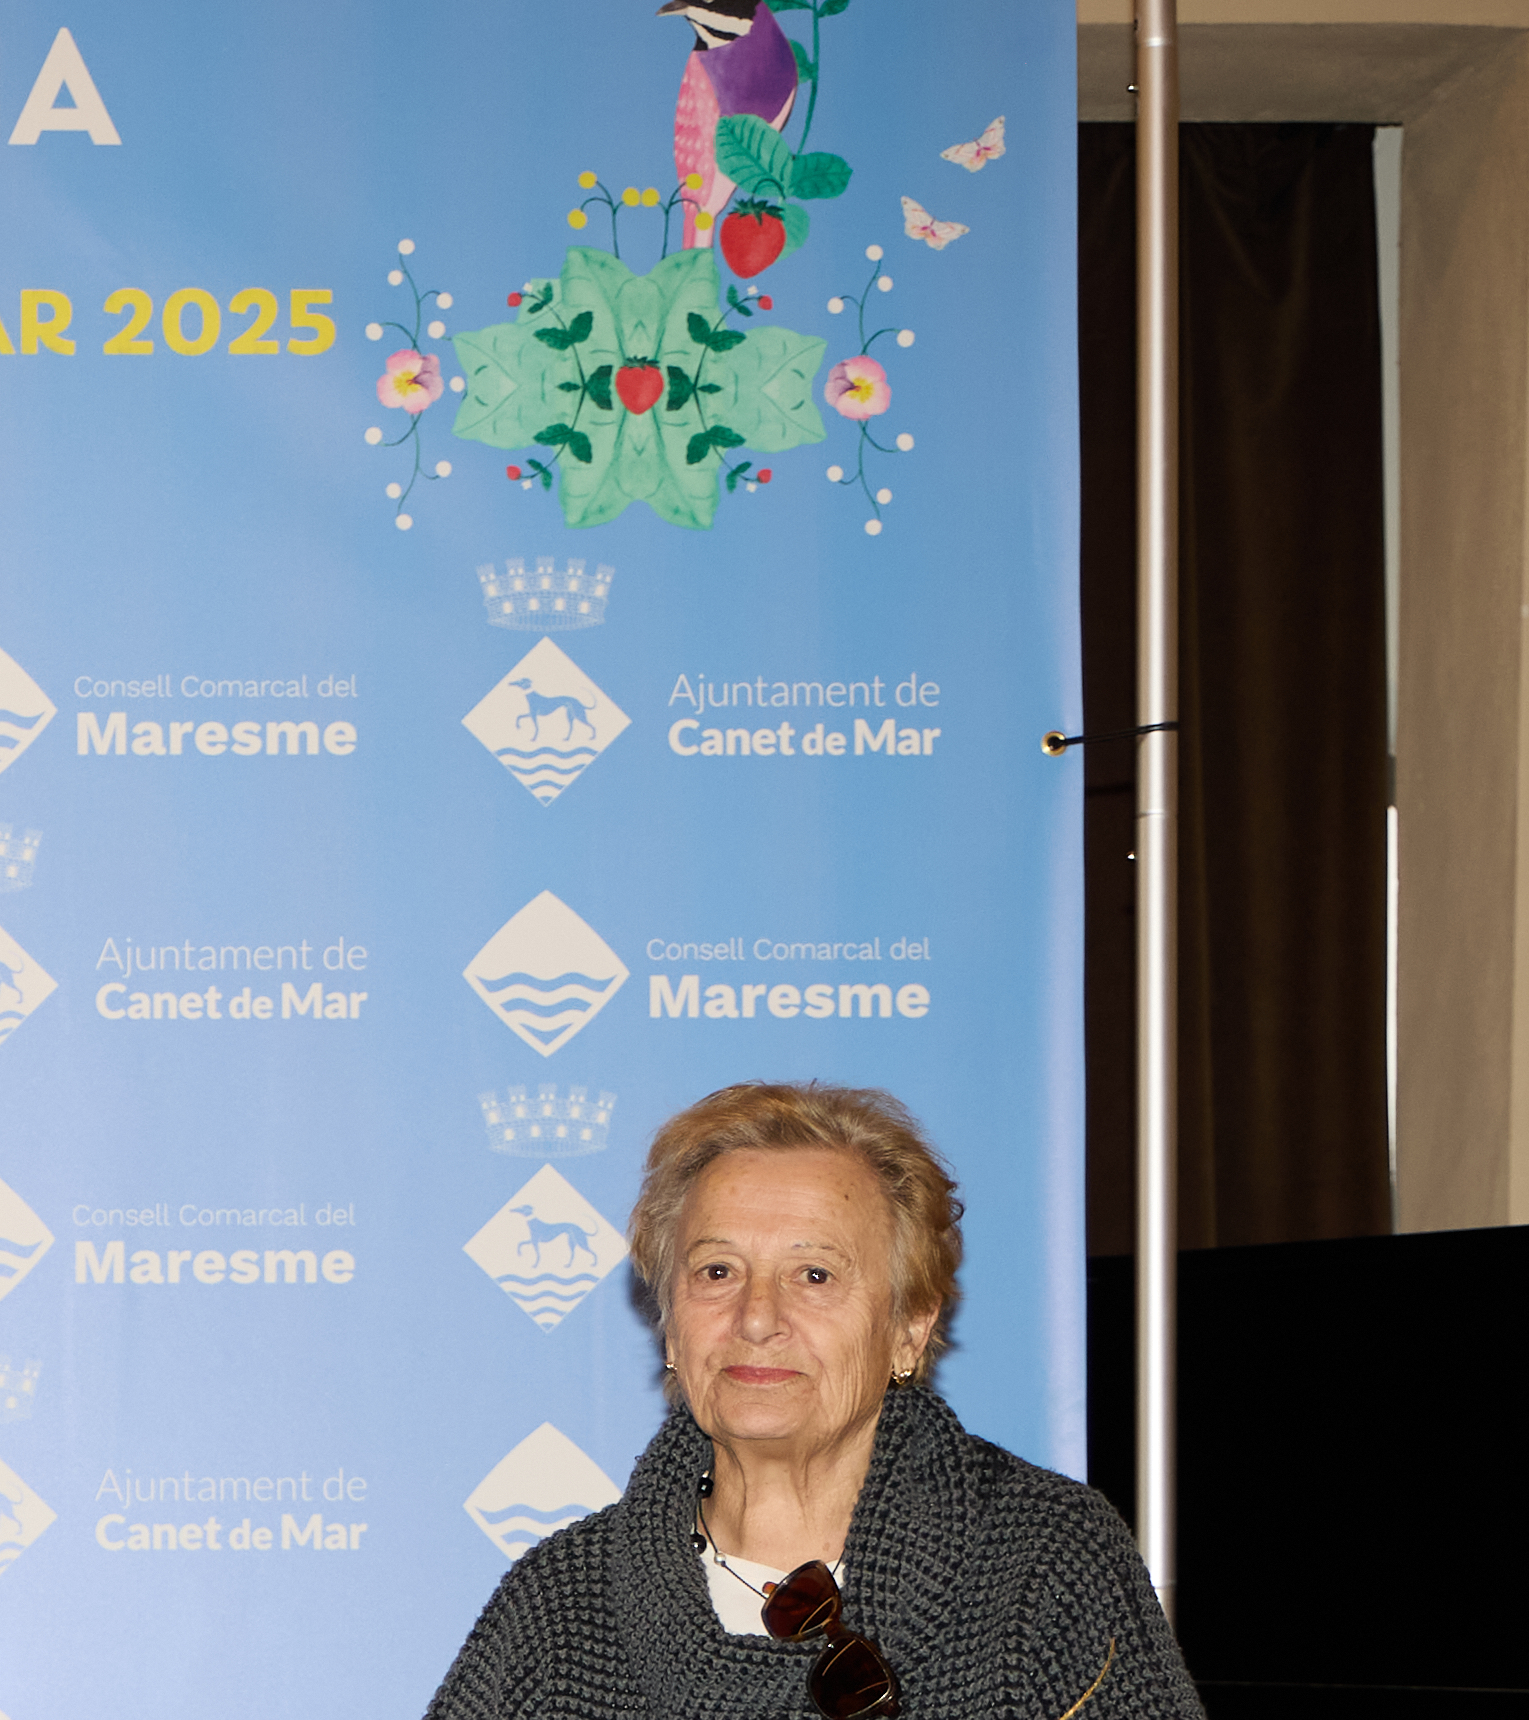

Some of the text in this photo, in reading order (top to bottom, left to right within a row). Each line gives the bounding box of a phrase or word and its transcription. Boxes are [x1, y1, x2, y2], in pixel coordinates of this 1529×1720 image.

[102, 286, 337, 357] 2025
[73, 673, 359, 699] Consell Comarcal del
[668, 671, 941, 715] Ajuntament de
[77, 711, 358, 756] Maresme
[668, 718, 942, 756] Canet de Mar
[95, 936, 369, 979] Ajuntament de
[646, 936, 932, 962] Consell Comarcal del
[95, 982, 369, 1020] Canet de Mar
[649, 974, 931, 1019] Maresme
[71, 1202, 356, 1227] Consell Comarcal del
[74, 1240, 356, 1285] Maresme
[95, 1467, 368, 1510] Ajuntament de
[95, 1513, 369, 1551] Canet de Mar
